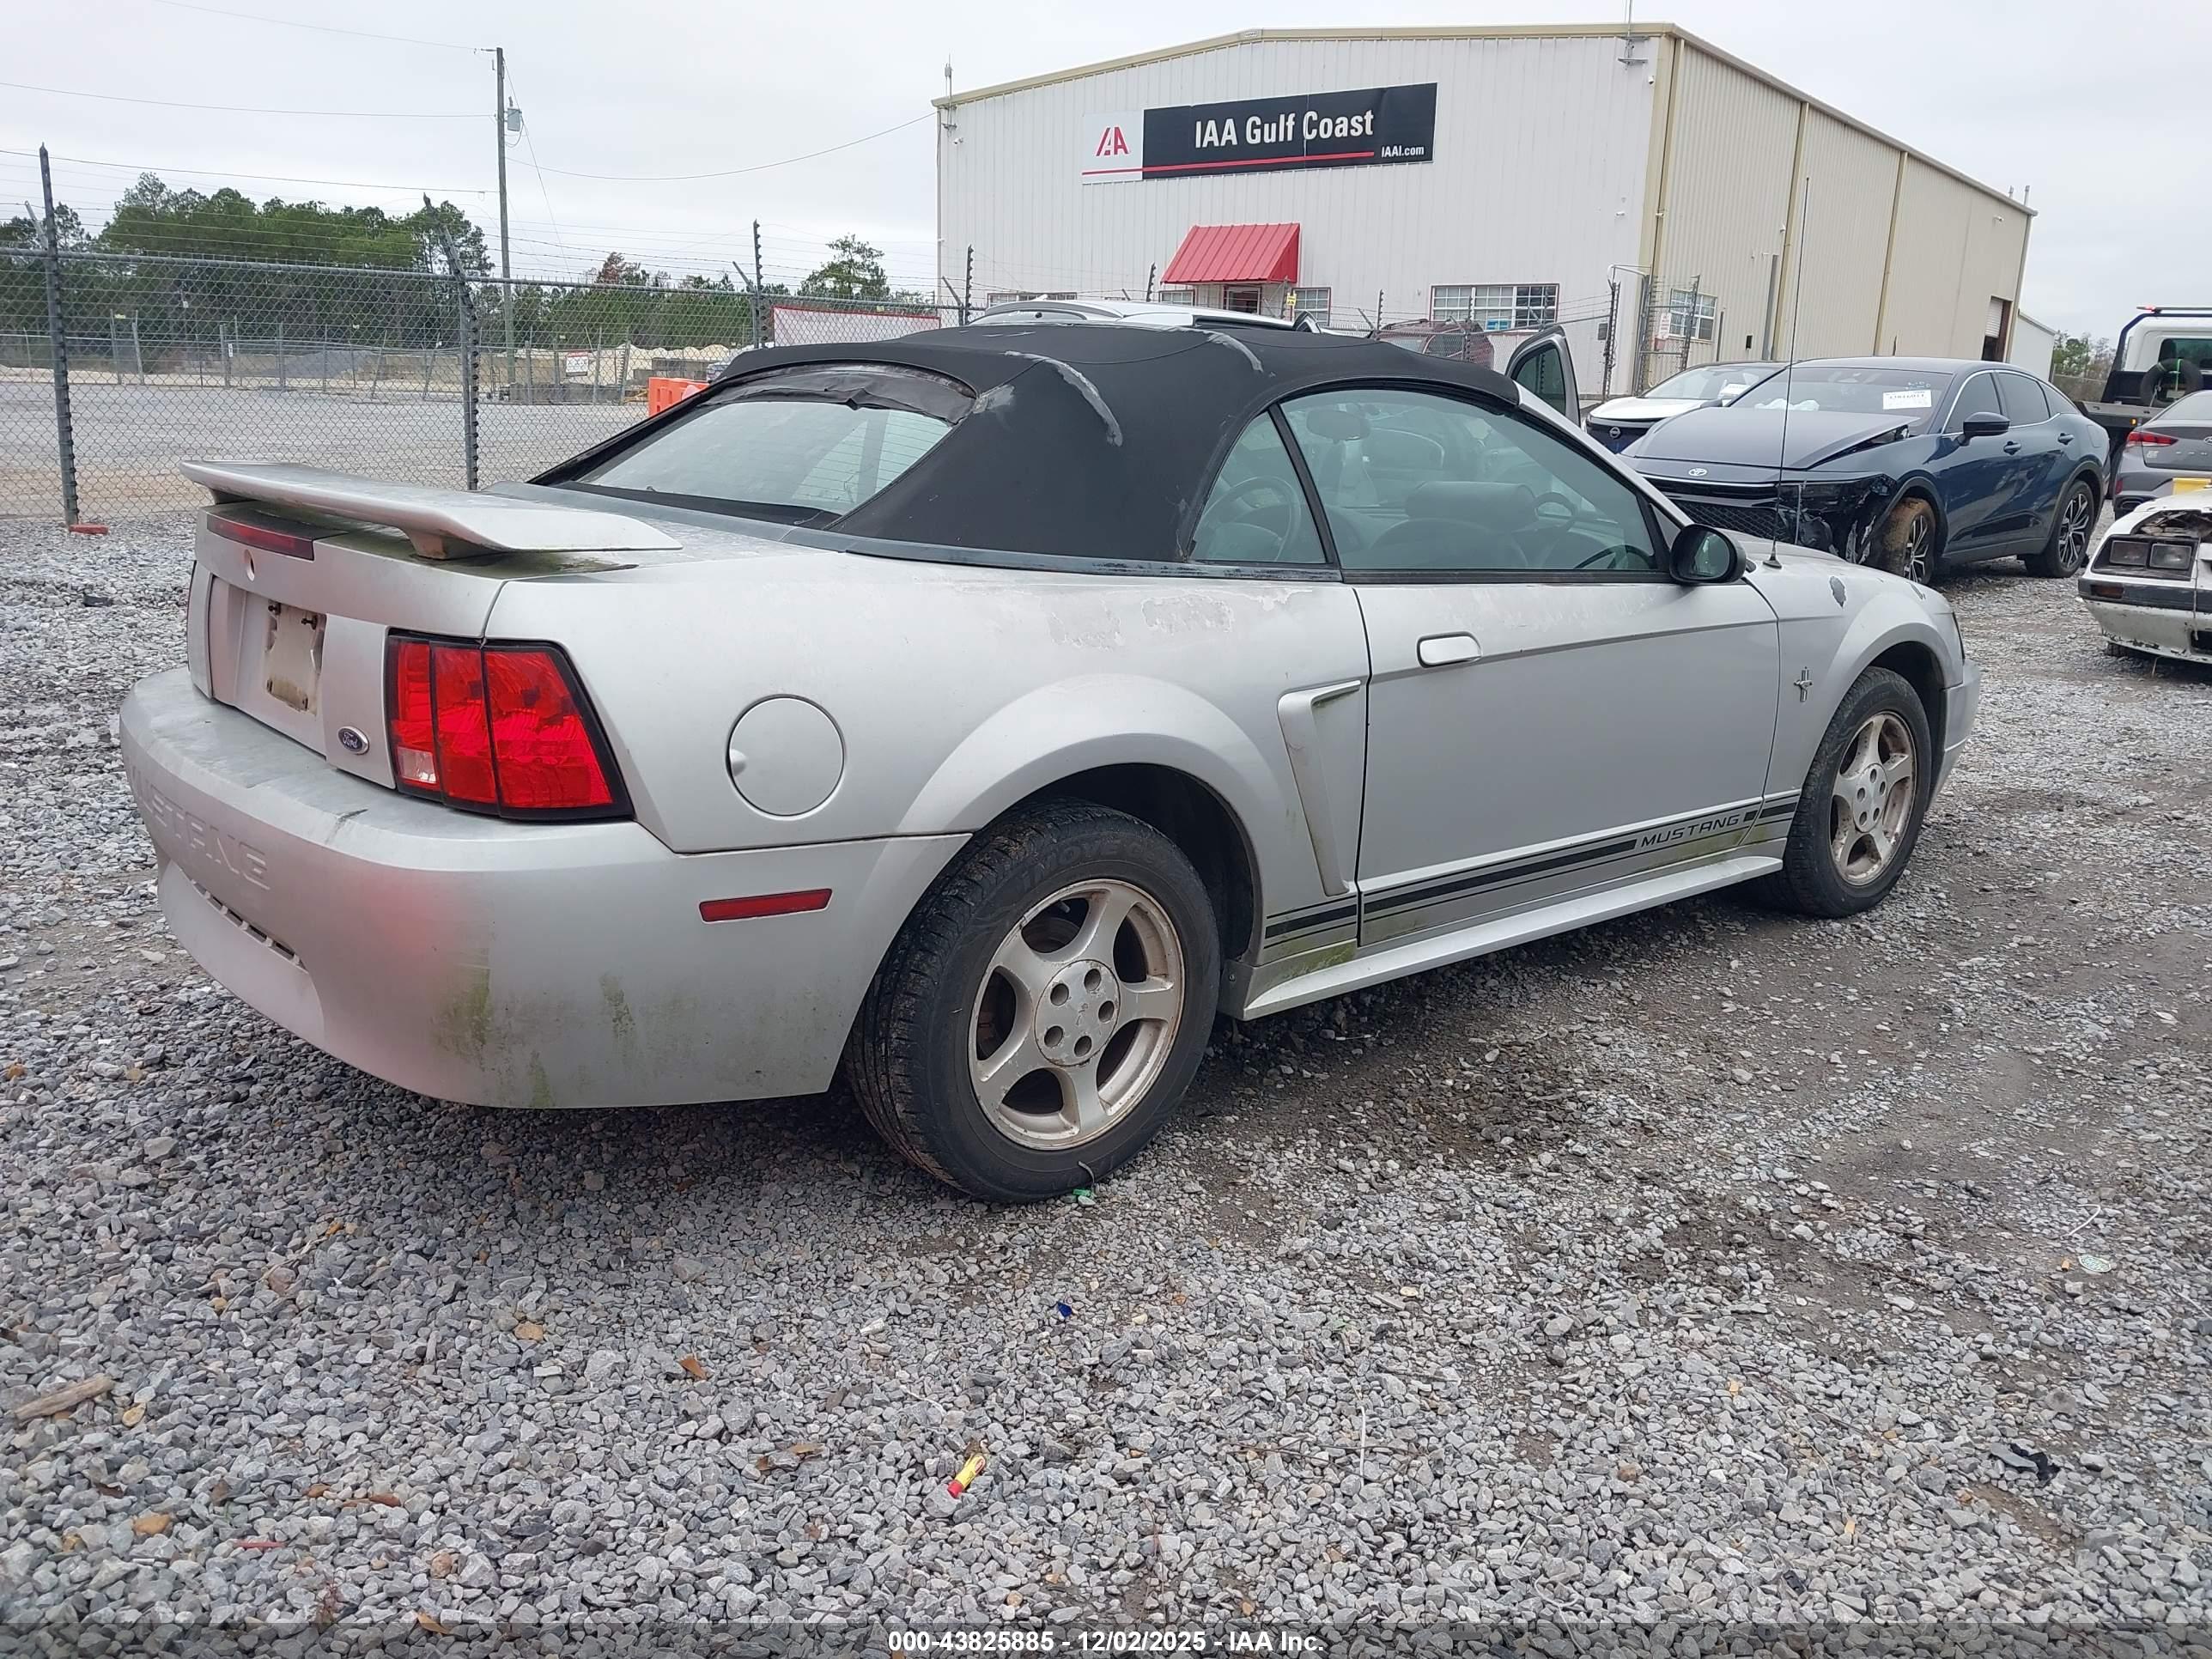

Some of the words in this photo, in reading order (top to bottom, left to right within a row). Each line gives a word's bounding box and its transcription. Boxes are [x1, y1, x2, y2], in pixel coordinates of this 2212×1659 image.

[1195, 118, 1237, 149] IAA
[1245, 112, 1296, 144] Gulf
[1303, 109, 1374, 140] Coast
[1381, 144, 1425, 158] IAAI.com
[1641, 814, 1740, 848] MUSTANG
